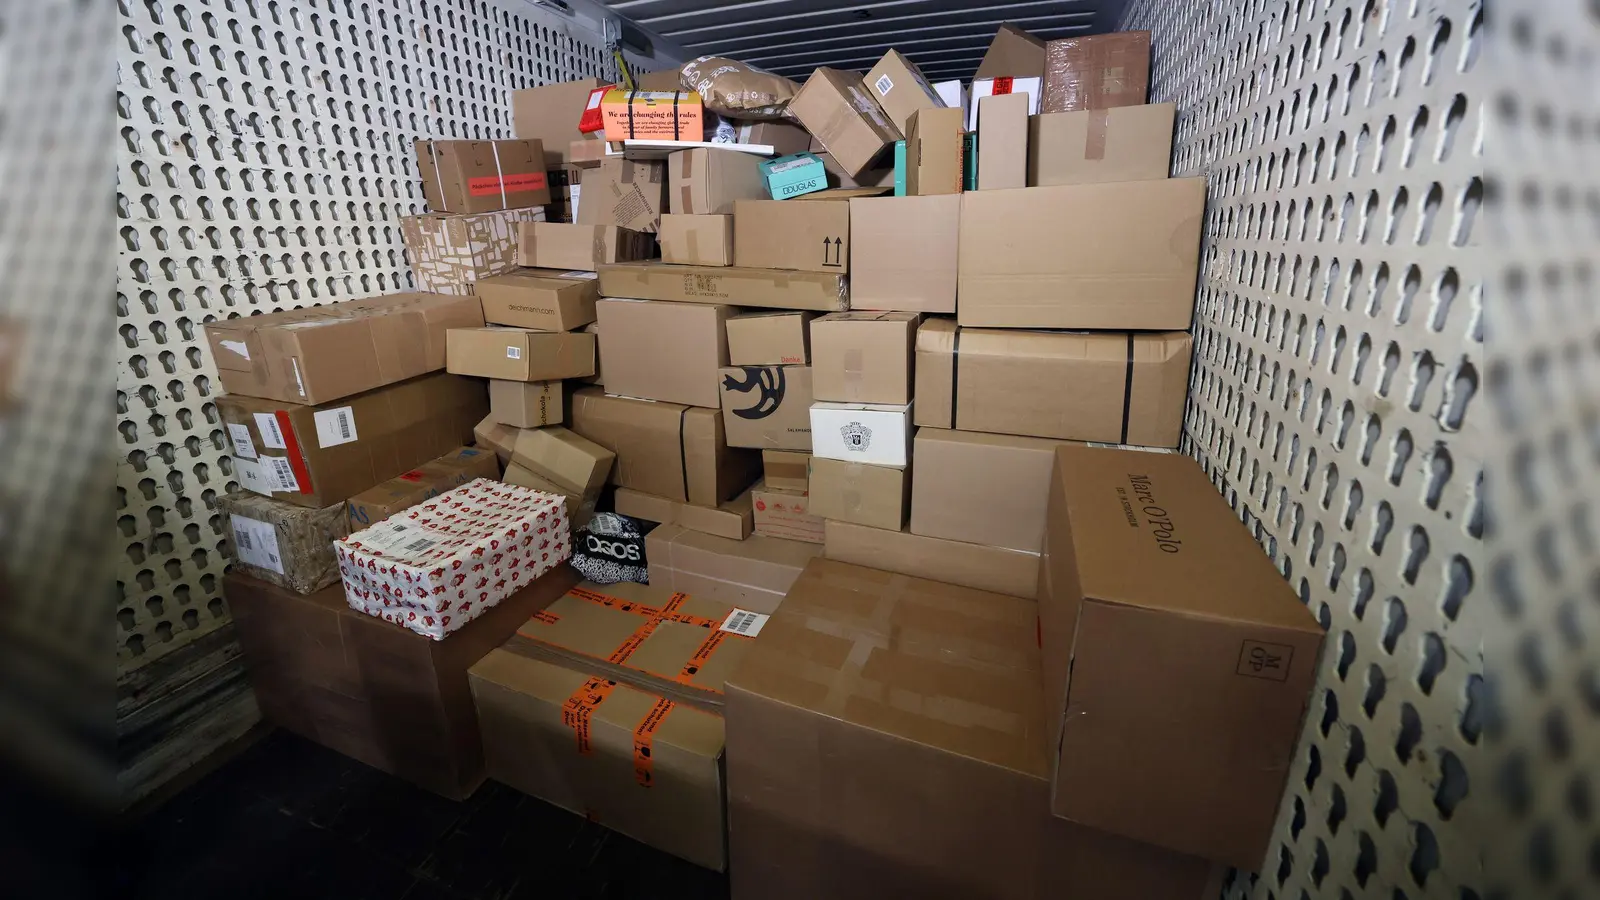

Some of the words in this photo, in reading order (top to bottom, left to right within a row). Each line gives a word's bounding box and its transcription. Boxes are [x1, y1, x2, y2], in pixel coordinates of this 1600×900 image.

[632, 111, 666, 119] changing
[782, 180, 817, 195] DOUGLAS
[508, 304, 555, 316] deichmann.com
[350, 503, 369, 524] AS
[1127, 473, 1155, 504] Marc
[1143, 506, 1182, 553] O'Polo
